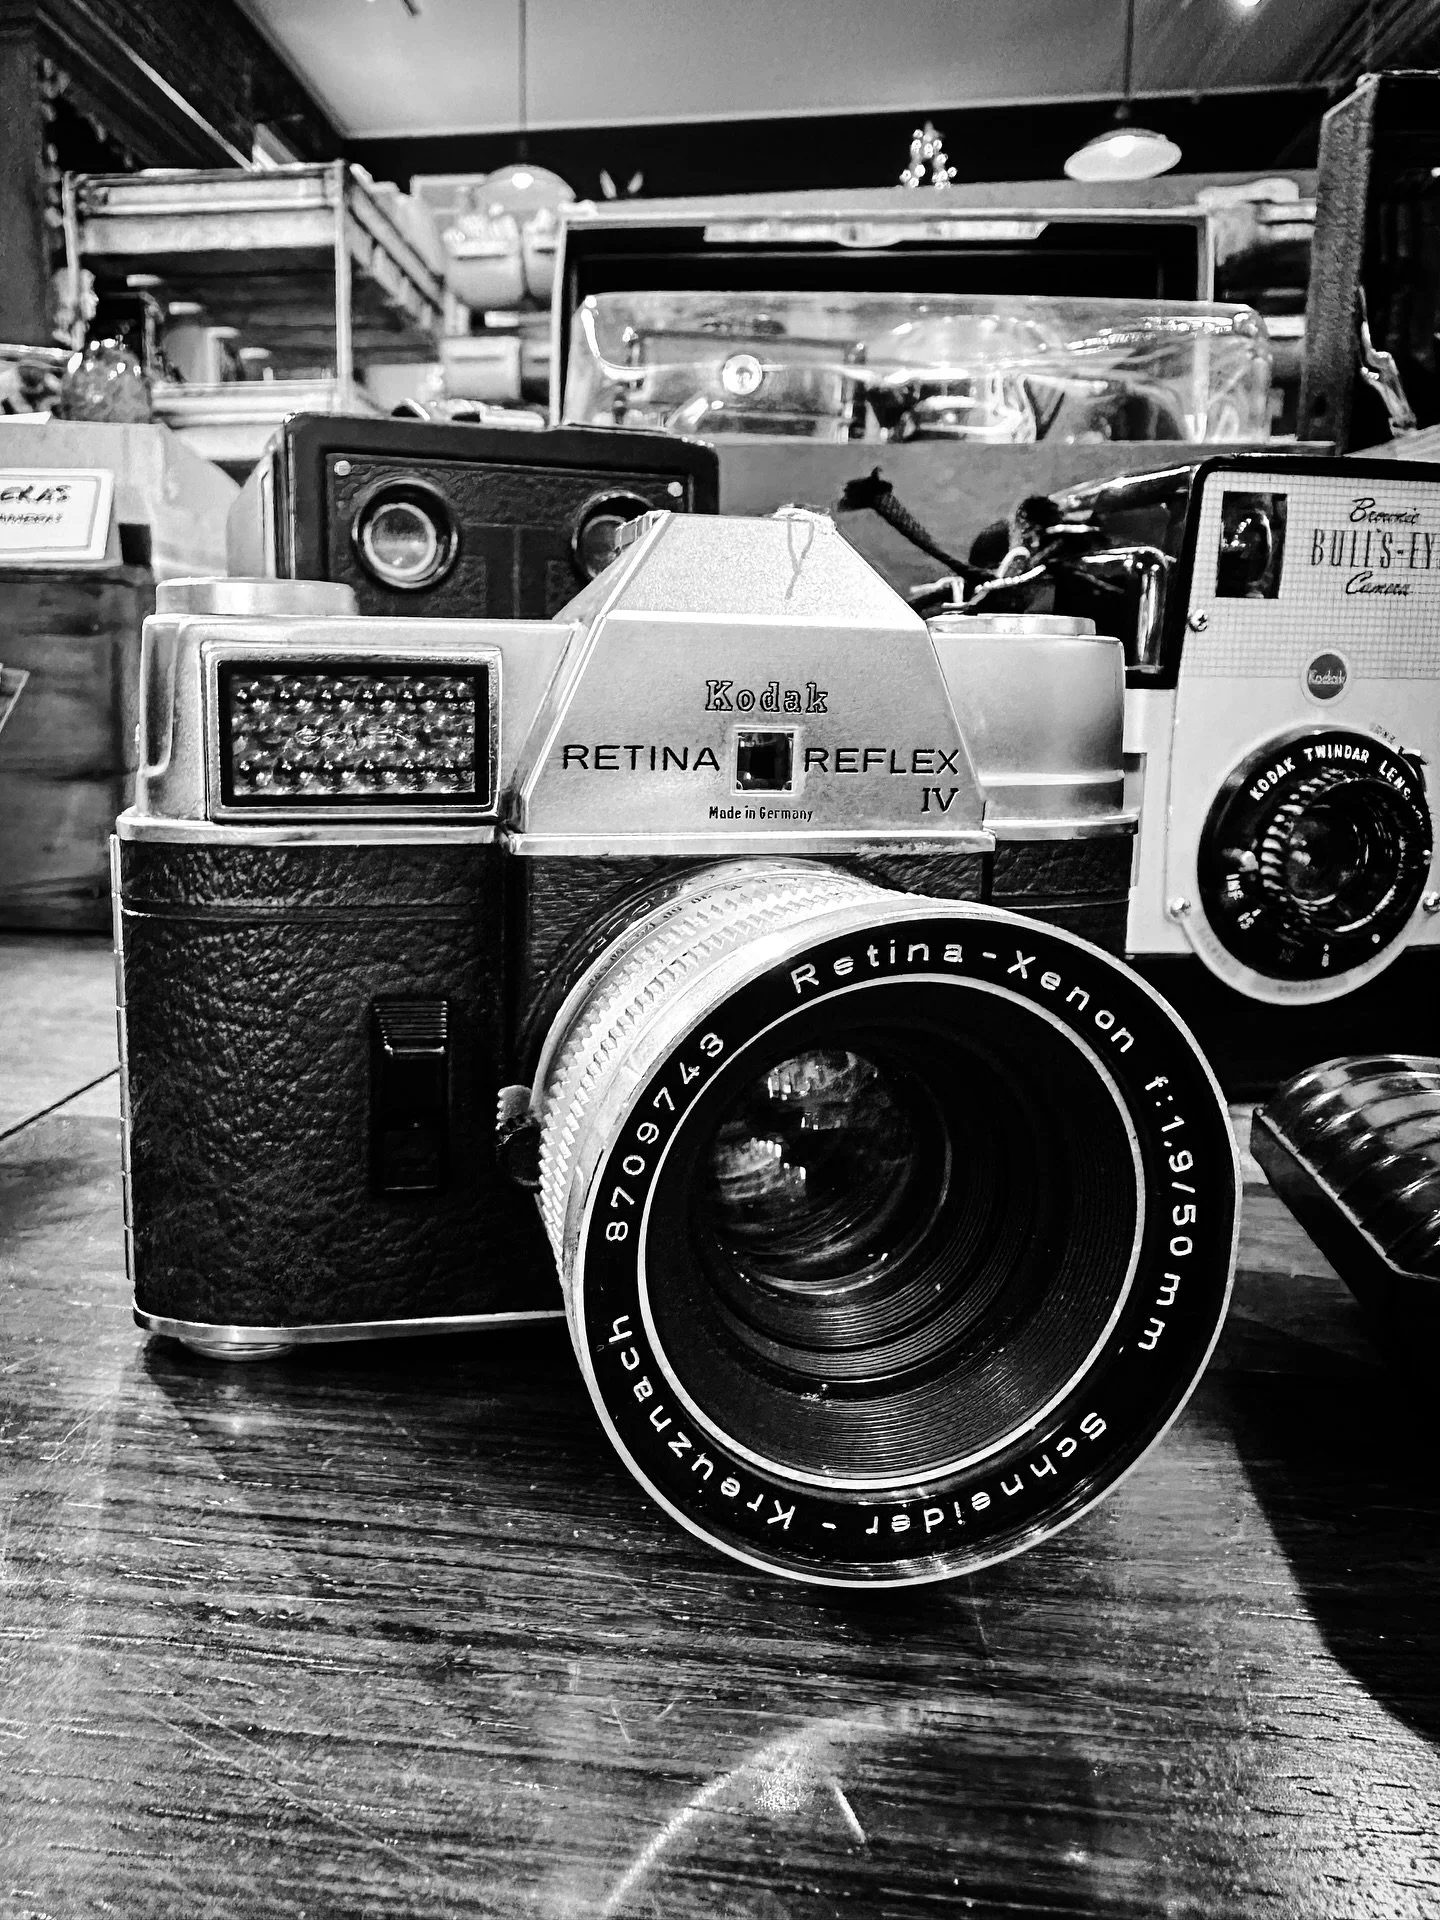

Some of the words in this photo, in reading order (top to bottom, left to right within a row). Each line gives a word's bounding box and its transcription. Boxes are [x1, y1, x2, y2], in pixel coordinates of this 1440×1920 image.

[1311, 528, 1440, 570] BULL'S-EY
[1346, 570, 1411, 596] Camera
[1307, 669, 1346, 685] Kodak
[705, 680, 828, 713] Kodak
[562, 744, 721, 772] RETINA
[804, 747, 960, 775] REFLEX
[1250, 757, 1296, 801] KODAK
[1303, 744, 1370, 763] TWINDAR
[709, 806, 741, 819] Made
[744, 805, 756, 819] in
[760, 807, 813, 822] Germany
[921, 787, 960, 814] IV
[790, 939, 1135, 1053] Retina-Xenon
[606, 1033, 724, 1241] 8709743
